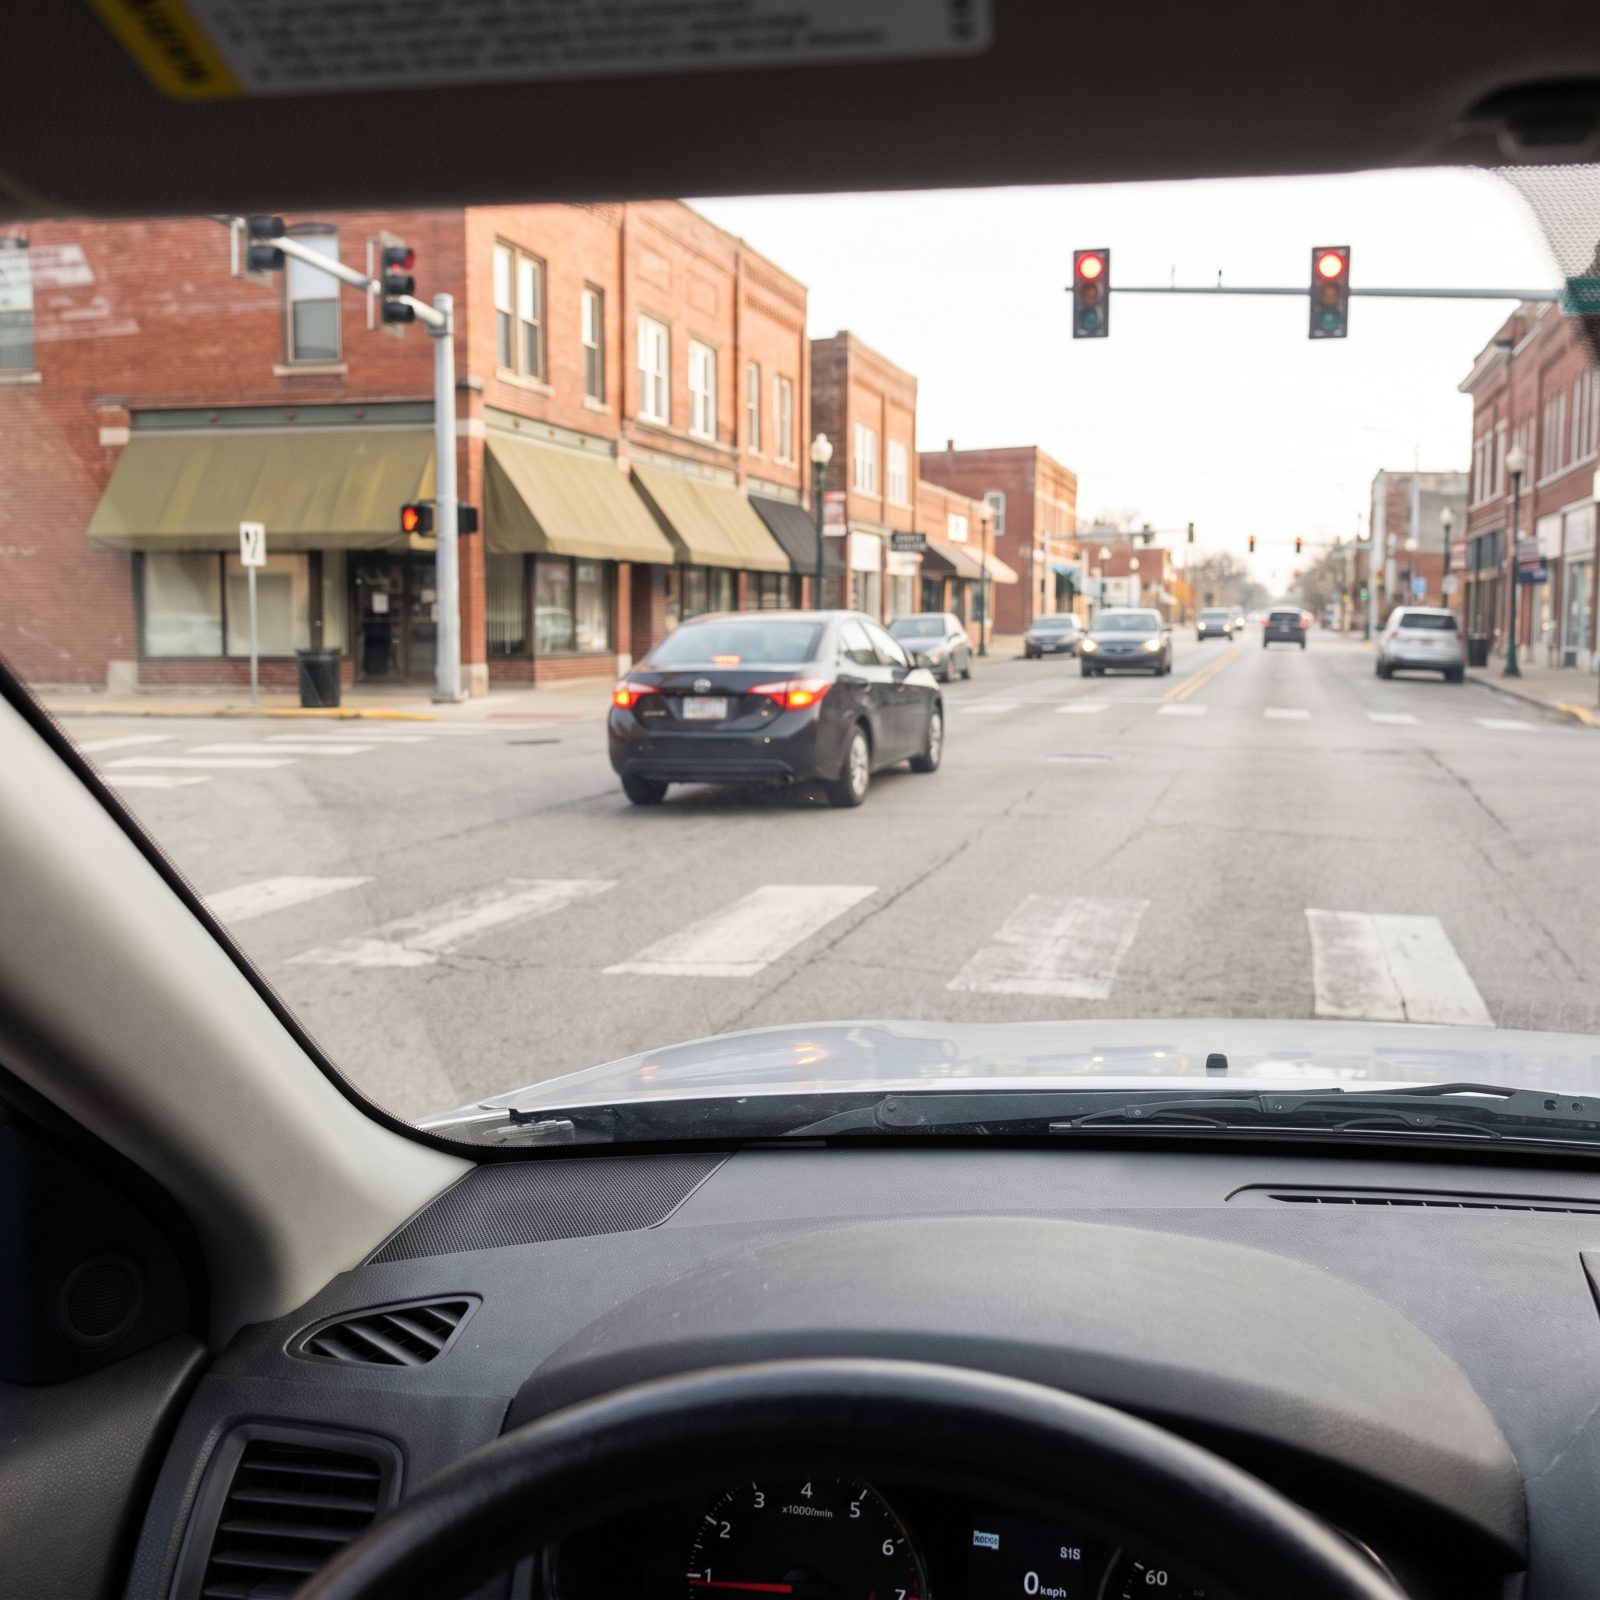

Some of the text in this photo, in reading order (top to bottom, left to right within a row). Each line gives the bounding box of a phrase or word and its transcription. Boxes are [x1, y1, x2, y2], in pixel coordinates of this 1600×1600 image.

[801, 1482, 812, 1498] 4
[754, 1492, 765, 1508] 3
[850, 1502, 861, 1518] 5
[719, 1521, 730, 1538] 2
[882, 1539, 894, 1555] 6
[704, 1568, 711, 1583] 1
[1023, 1571, 1039, 1595] 0
[1145, 1569, 1168, 1586] 60
[895, 1589, 906, 1600] 7
